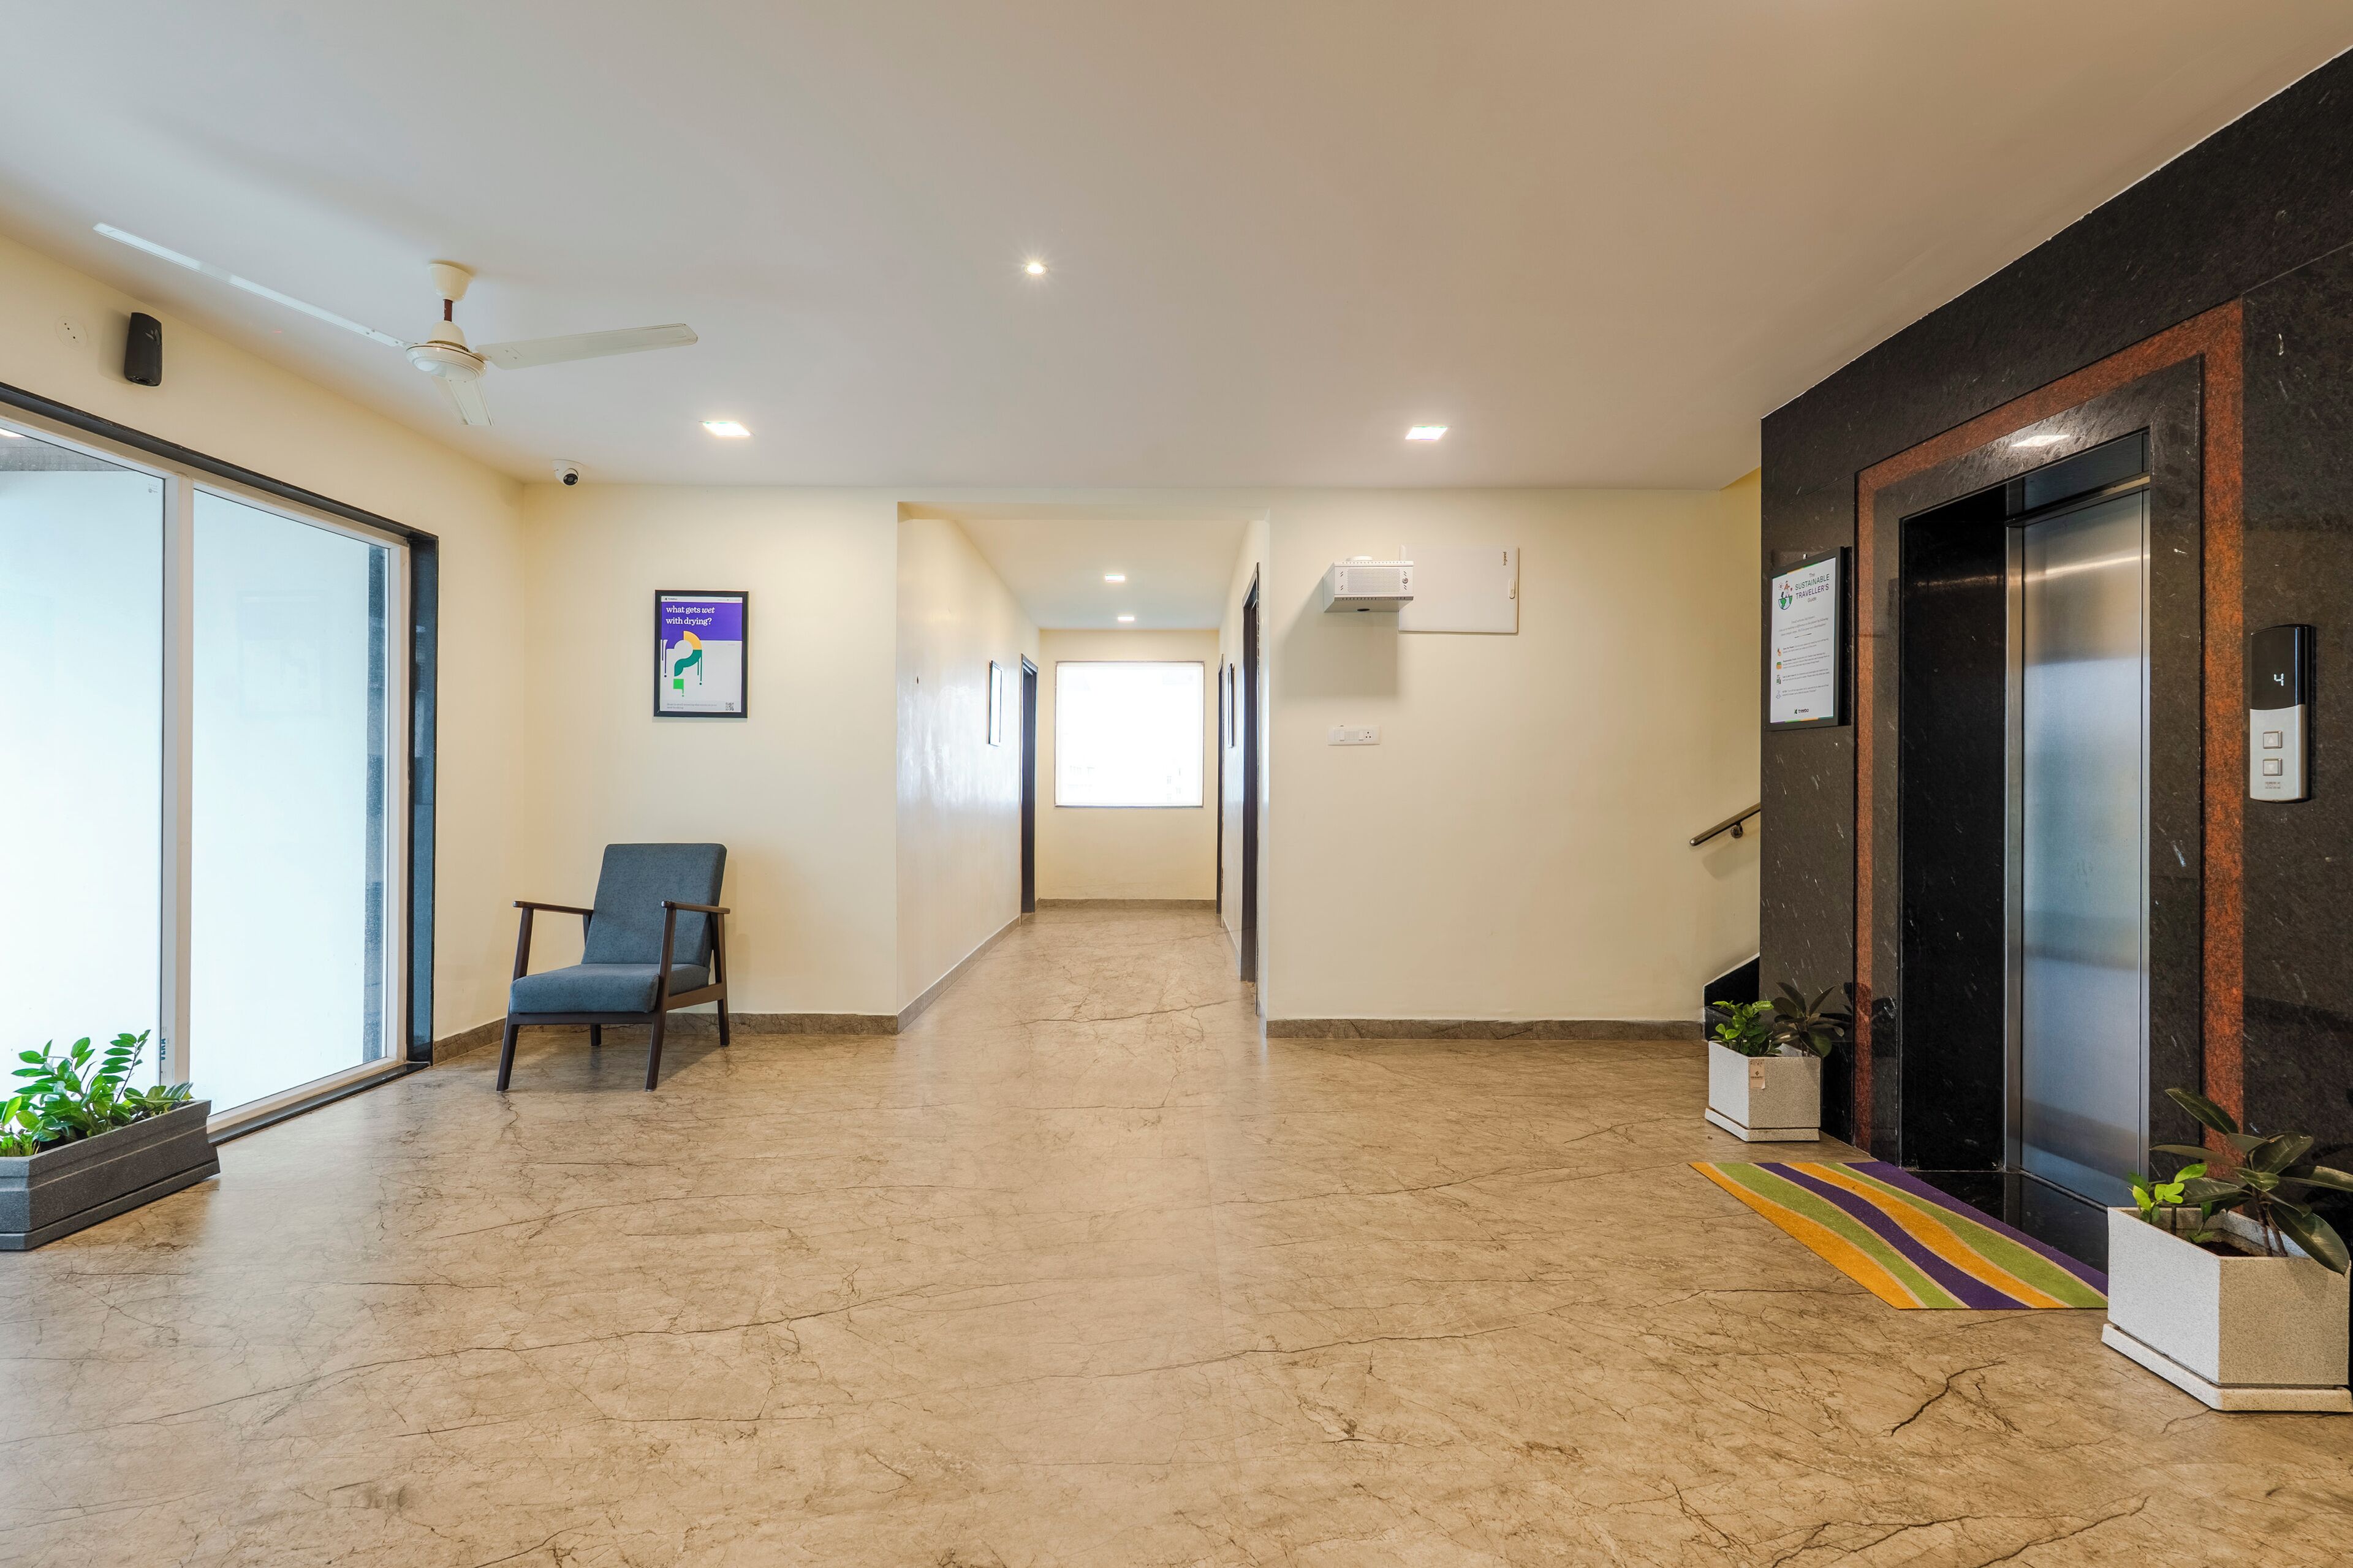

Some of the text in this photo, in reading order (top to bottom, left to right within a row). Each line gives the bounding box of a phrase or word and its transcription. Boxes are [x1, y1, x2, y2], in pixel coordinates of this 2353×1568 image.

[1795, 574, 1830, 590] SUSTAINABLE
[1795, 583, 1829, 599] TRAVELLER'S
[684, 617, 712, 626] drying?
[2274, 673, 2284, 686] 4
